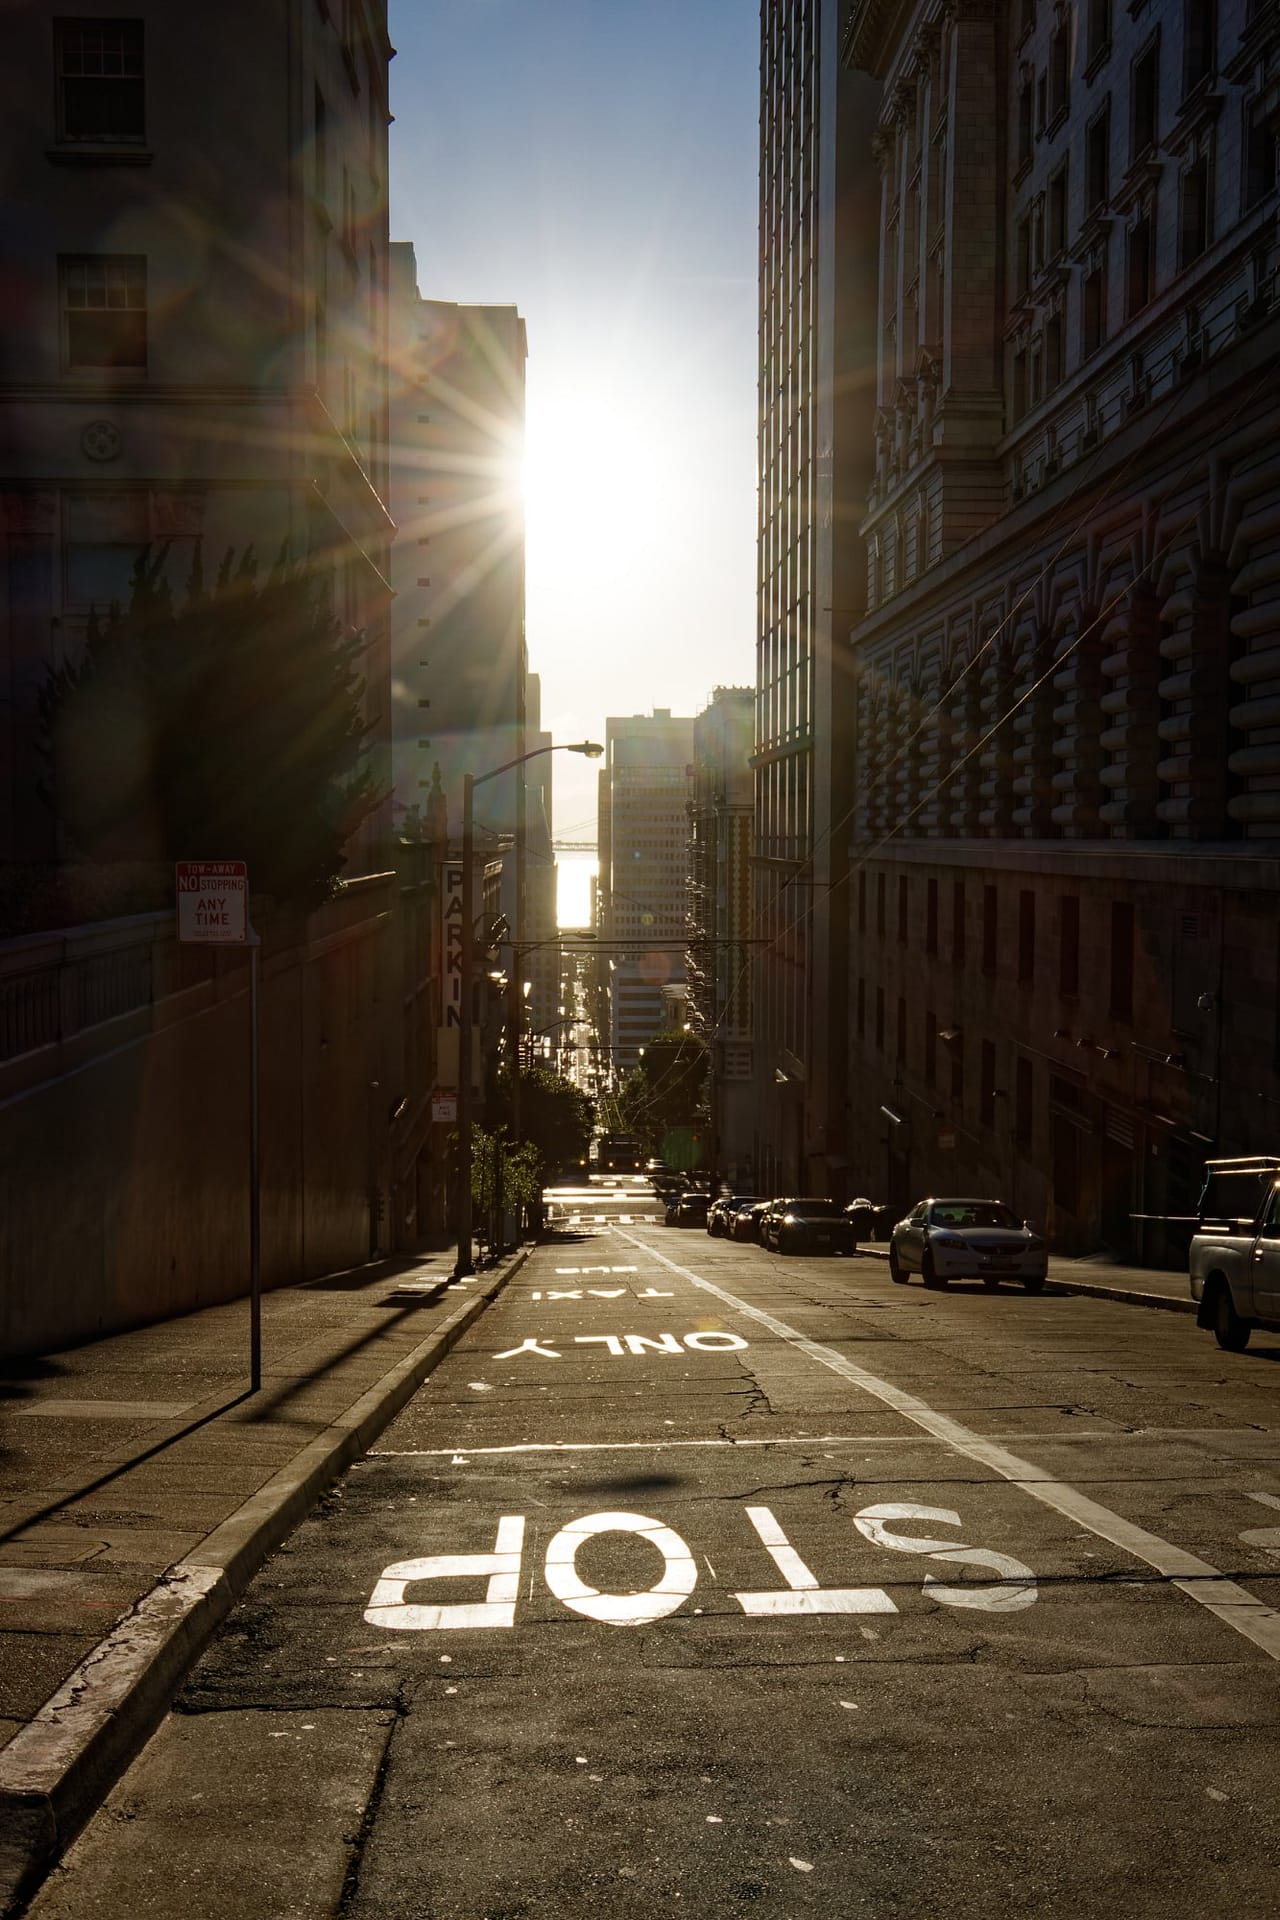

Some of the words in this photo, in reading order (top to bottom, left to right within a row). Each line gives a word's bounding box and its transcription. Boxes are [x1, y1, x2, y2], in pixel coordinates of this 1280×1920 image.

[186, 864, 235, 874] TOW-AWAY
[179, 876, 198, 890] NO
[201, 880, 243, 890] STOPPING
[198, 899, 225, 910] ANY
[195, 914, 229, 925] TIME
[532, 1288, 674, 1300] TAXI
[491, 1331, 749, 1359] ONLY
[363, 1502, 1038, 1628] STOP
